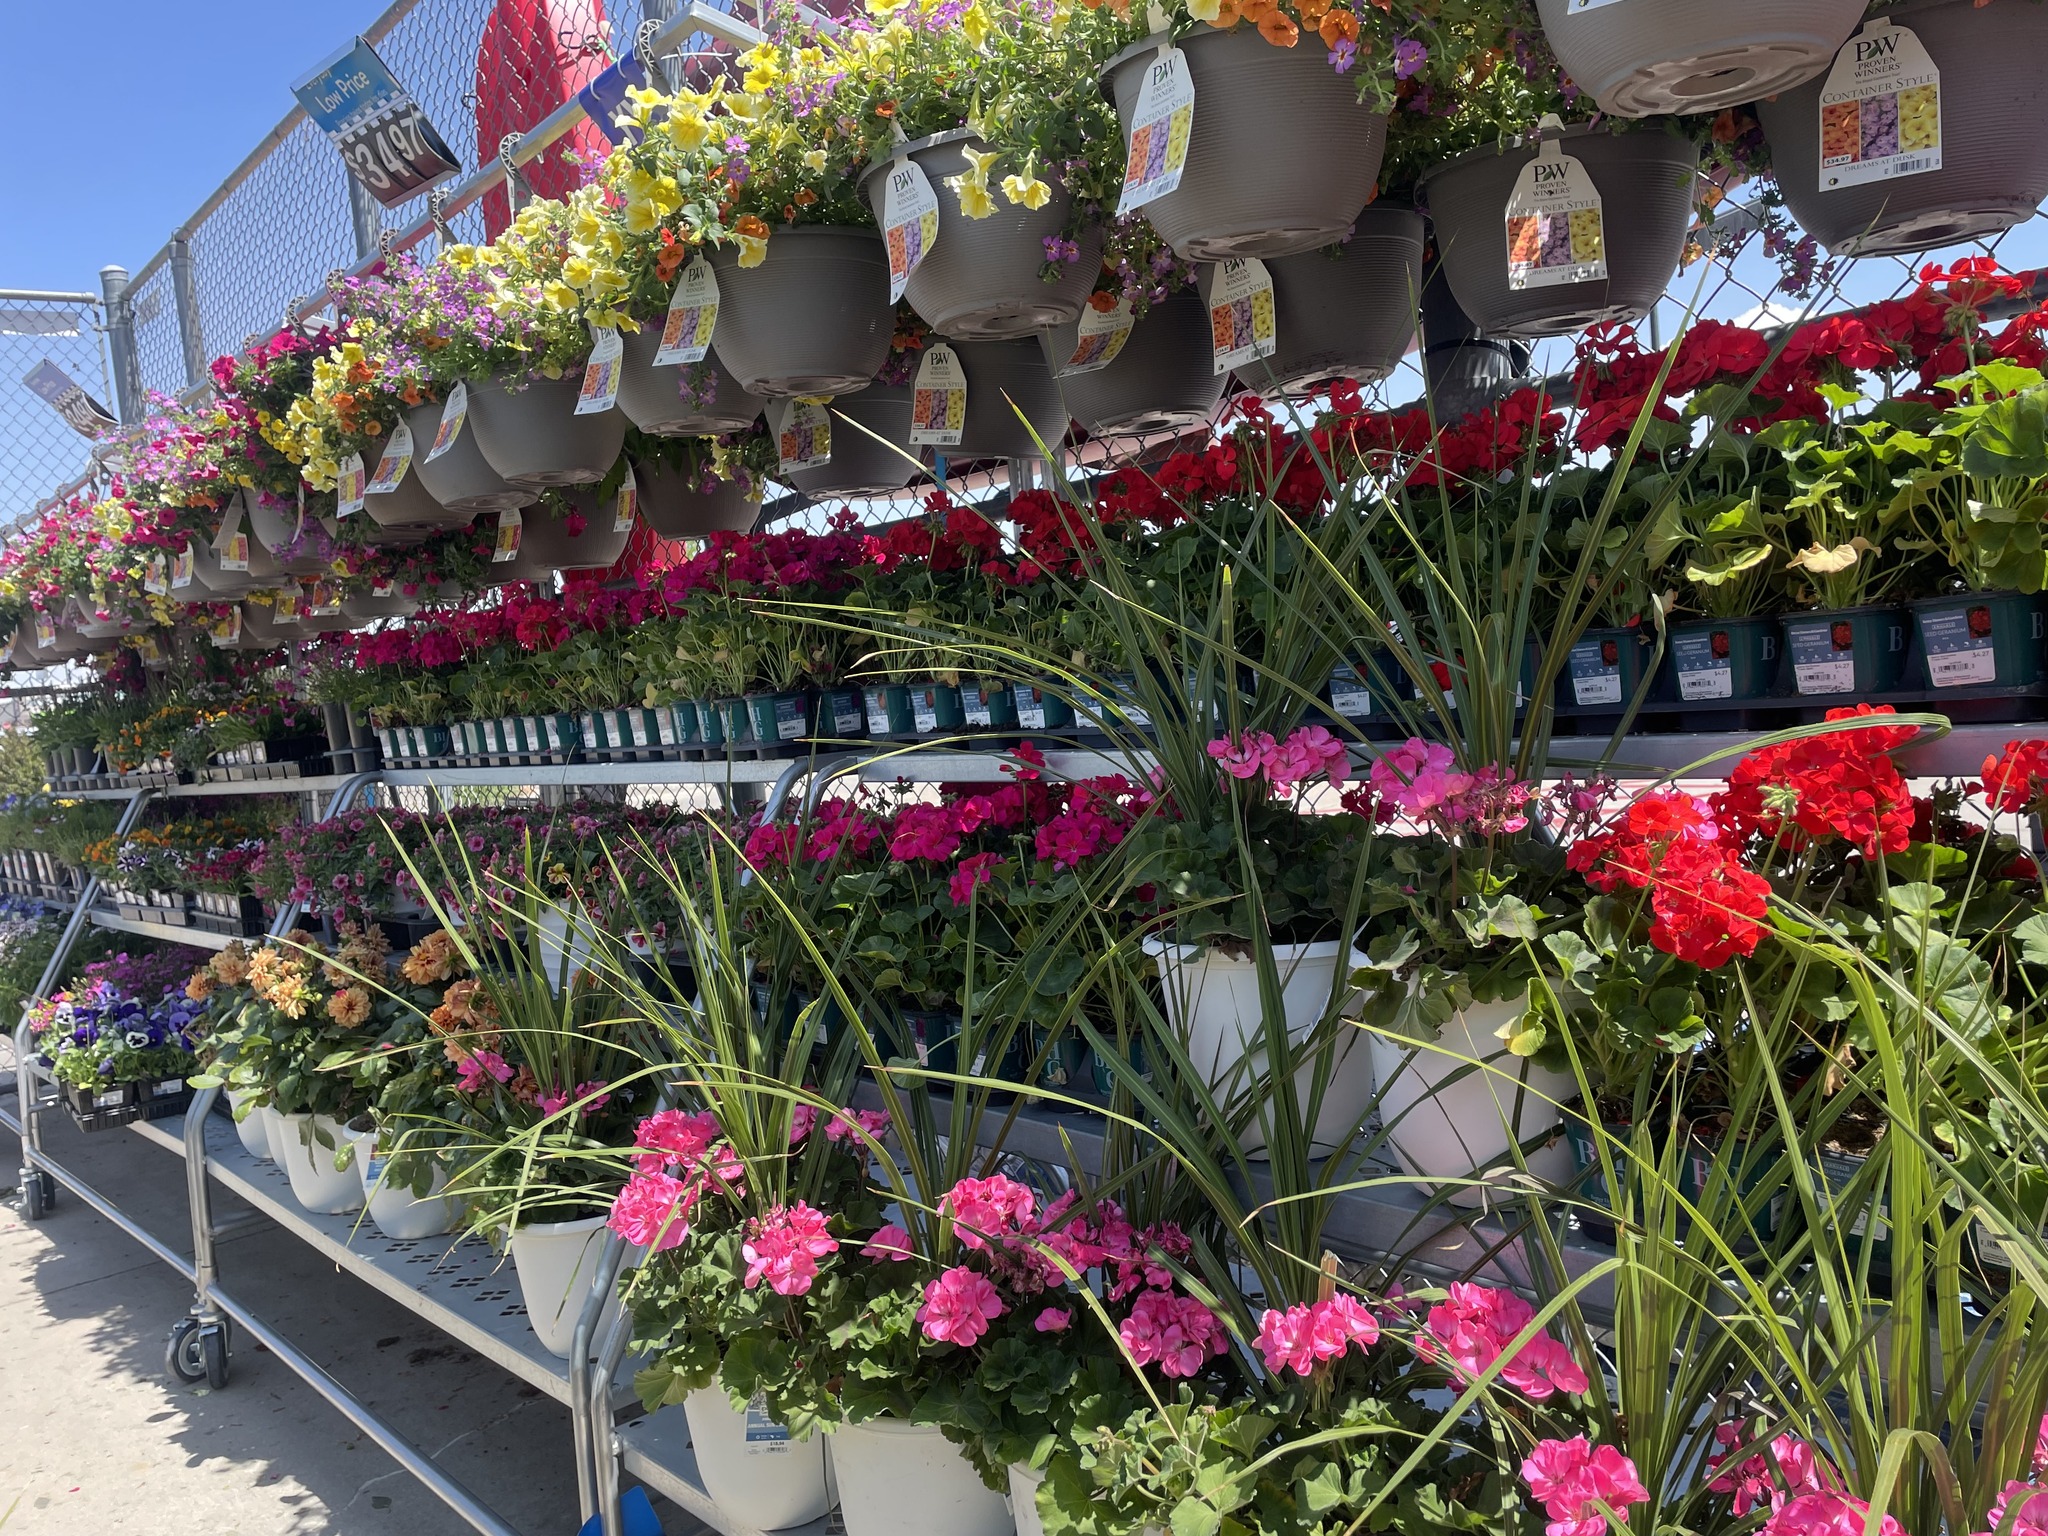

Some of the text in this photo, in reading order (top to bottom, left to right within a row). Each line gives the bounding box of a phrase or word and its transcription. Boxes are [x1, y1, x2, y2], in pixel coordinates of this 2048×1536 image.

[1856, 33, 1901, 62] PW
[1152, 55, 1178, 87] PW
[1854, 63, 1901, 79] WINNERS
[1858, 56, 1897, 70] PROVEN
[314, 90, 345, 114] Low
[335, 71, 370, 99] Price
[1151, 85, 1176, 102] WINNERS
[1153, 79, 1175, 94] PROVEN
[1823, 82, 1893, 104] CONTAINER
[1896, 73, 1934, 89] STYLE
[1132, 105, 1171, 130] CONTAINER
[1171, 94, 1192, 112] STYLE
[1826, 156, 1850, 165] $34.97
[1844, 161, 1879, 172] DREAMS
[1892, 154, 1915, 163] DUSK
[893, 167, 915, 193] PW
[1533, 162, 1571, 183] PW
[897, 187, 916, 199] PROVEN
[1535, 180, 1567, 190] PROVEN
[896, 193, 918, 206] WINNERS
[1509, 199, 1597, 217] CONTAINER STYLE
[886, 209, 917, 229] CONTAINER
[917, 200, 936, 215] STYLE
[688, 265, 707, 282] PW
[1223, 258, 1246, 275] PW
[1226, 268, 1248, 280] PROVEN
[1225, 273, 1251, 286] WINNERS
[1211, 289, 1248, 307] CONTAINER
[1248, 281, 1269, 293] STYLE
[930, 352, 950, 365] PW
[1972, 650, 1990, 658] $4.27
